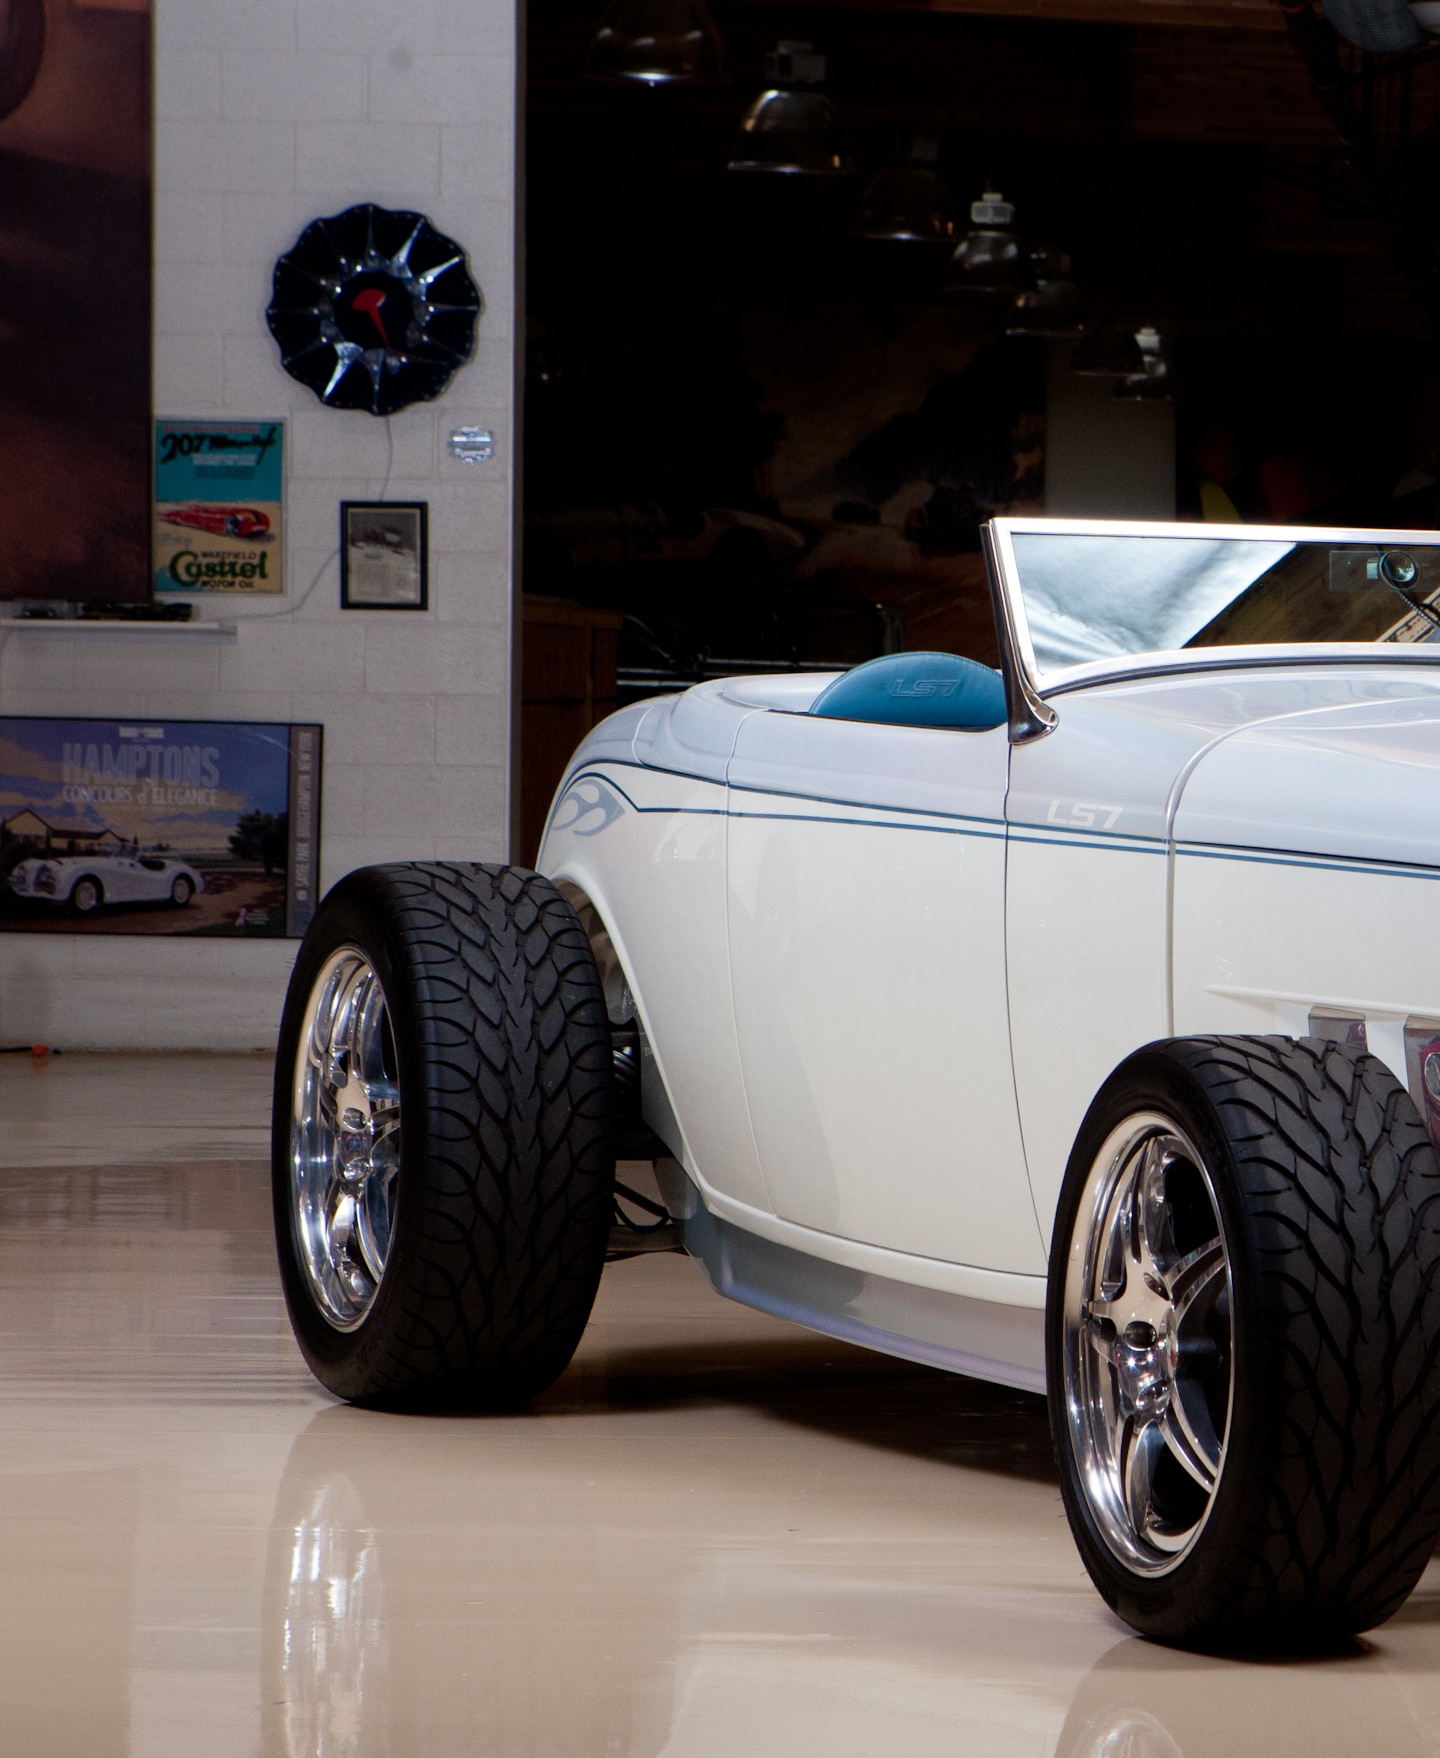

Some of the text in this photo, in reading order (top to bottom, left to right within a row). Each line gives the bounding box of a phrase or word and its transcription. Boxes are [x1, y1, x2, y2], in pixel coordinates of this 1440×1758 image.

[161, 433, 208, 464] 207
[169, 550, 269, 588] Castrol
[201, 579, 235, 589] MOTOR
[891, 679, 960, 698] LS7
[62, 742, 220, 788] HAMPTONS
[1046, 799, 1124, 830] LS7
